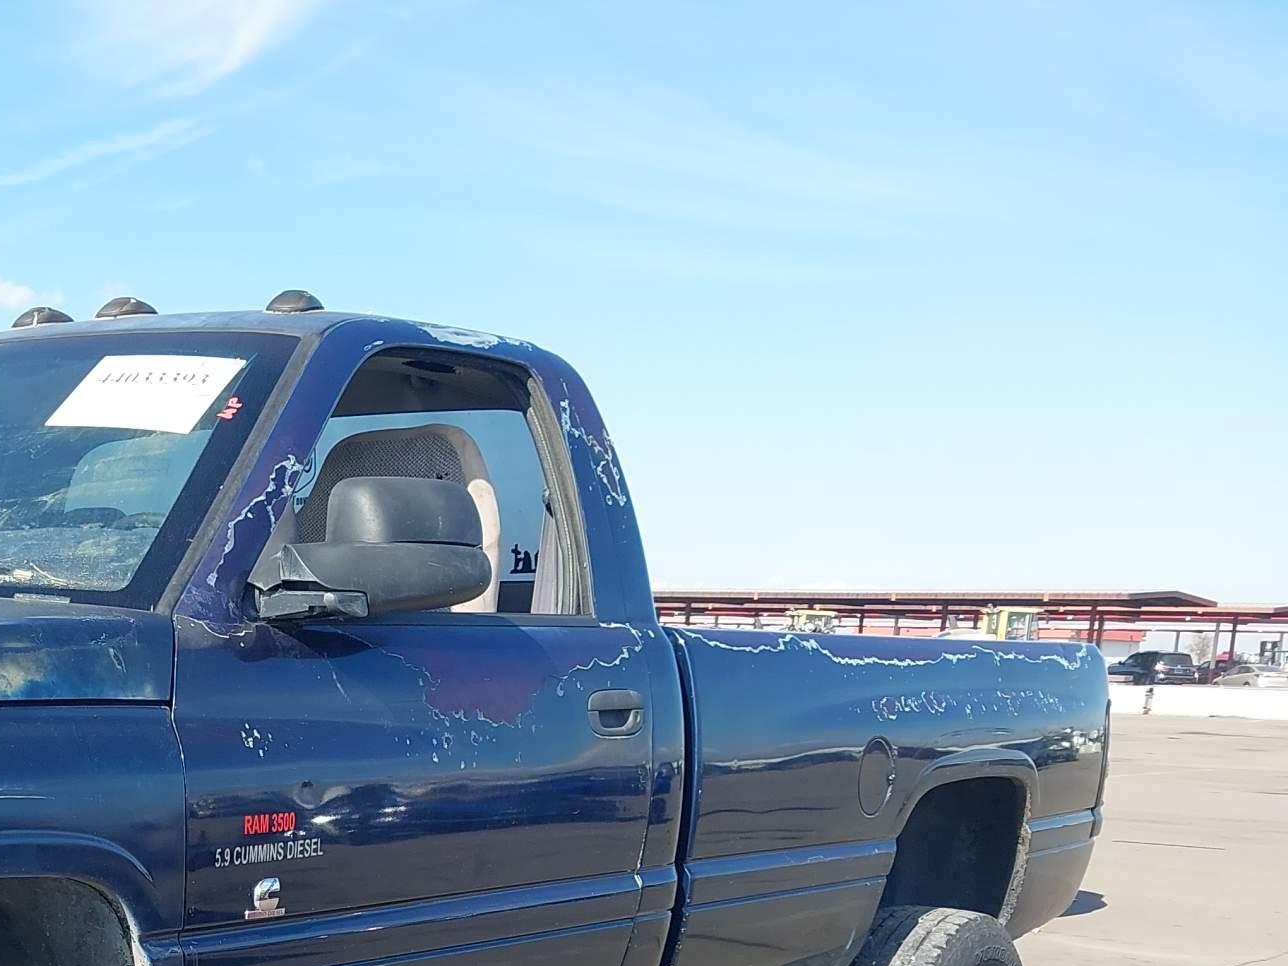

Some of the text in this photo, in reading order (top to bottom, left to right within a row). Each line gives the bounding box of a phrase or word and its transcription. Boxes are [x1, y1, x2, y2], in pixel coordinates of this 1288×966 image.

[244, 812, 296, 835] RAM 3500
[215, 838, 324, 868] 5.9 CUMMINS DIESEL
